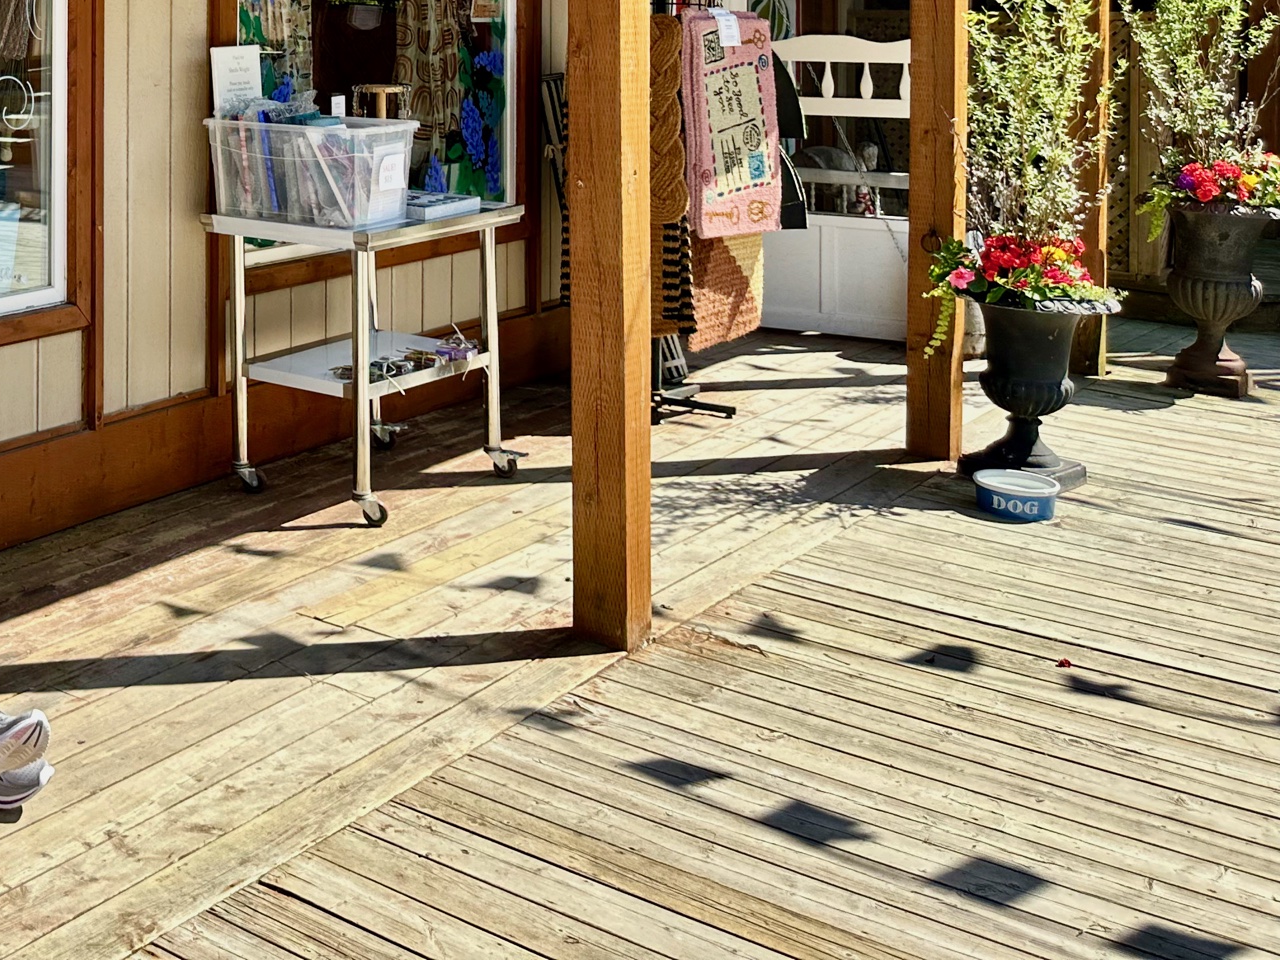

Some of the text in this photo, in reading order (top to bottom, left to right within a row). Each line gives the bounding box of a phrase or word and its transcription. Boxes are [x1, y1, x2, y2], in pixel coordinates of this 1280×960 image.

[722, 74, 730, 93] to
[713, 87, 725, 115] you
[991, 494, 1039, 515] DOG
